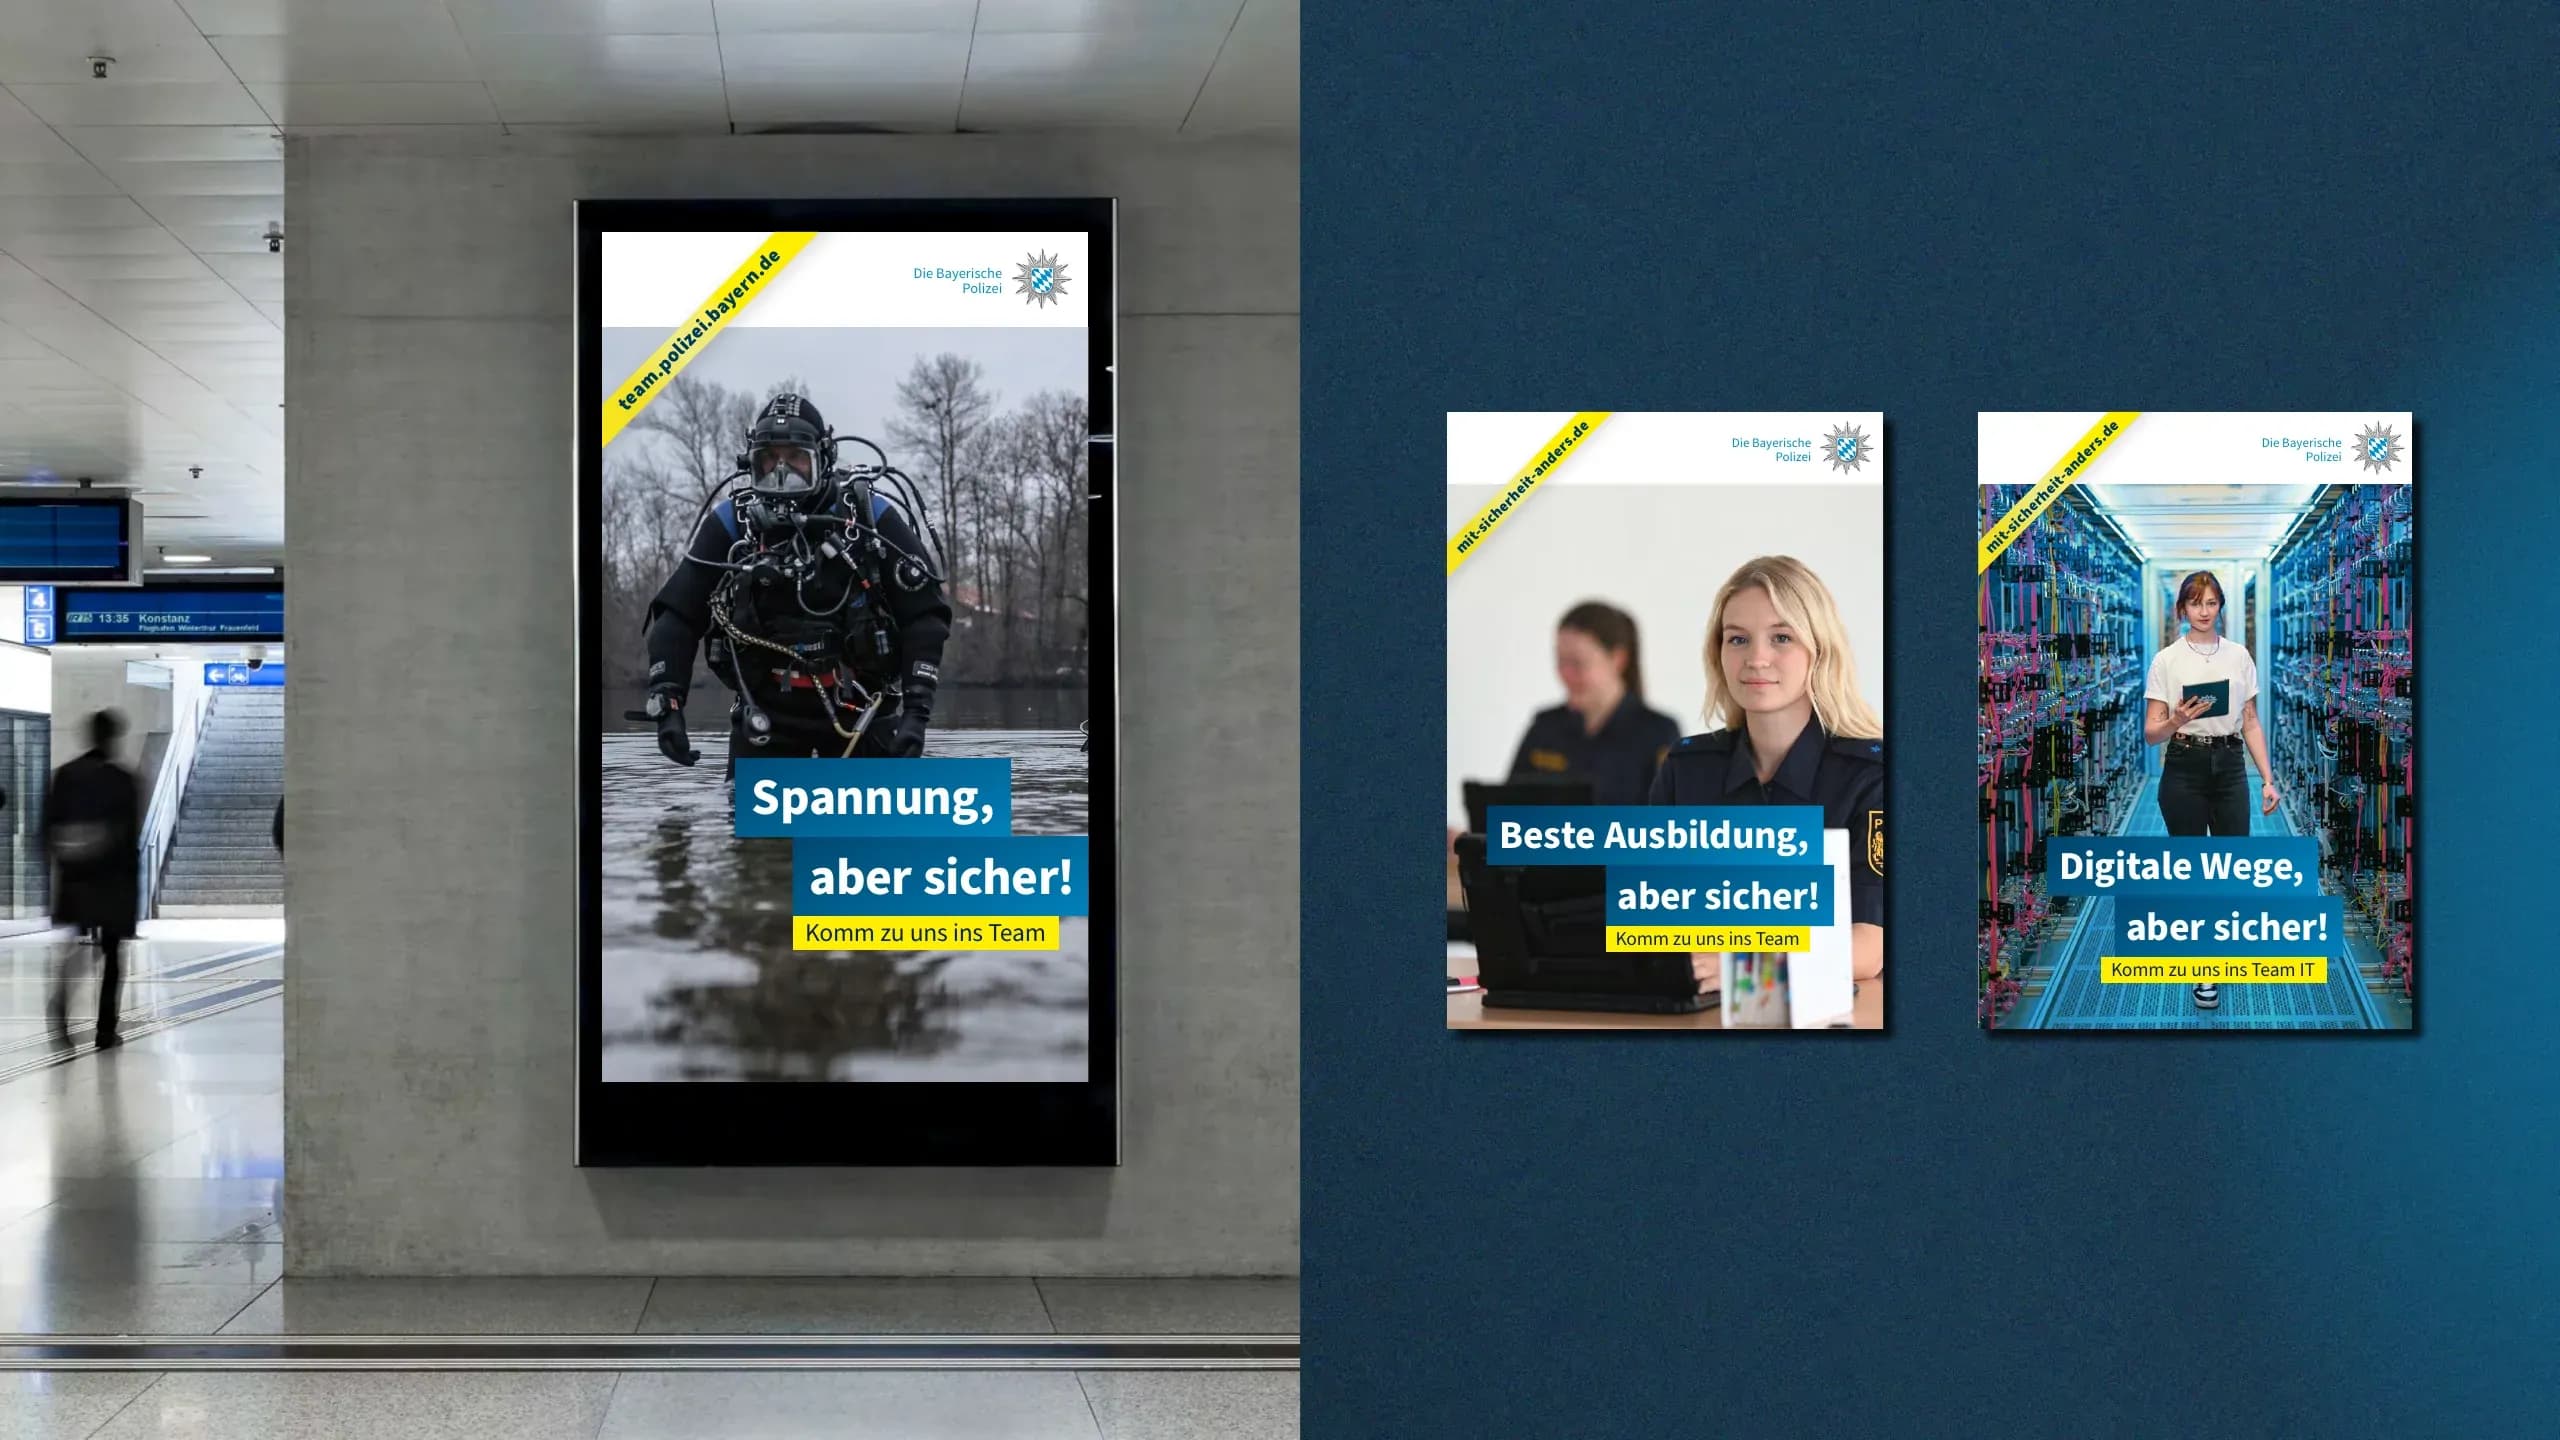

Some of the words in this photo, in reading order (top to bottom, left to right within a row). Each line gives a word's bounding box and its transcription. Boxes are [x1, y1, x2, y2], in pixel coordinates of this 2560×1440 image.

[913, 267, 934, 279] Die
[936, 267, 1002, 282] Bayerische
[962, 282, 1002, 294] Polizei
[618, 249, 781, 410] team.polizei.bayern.de
[1732, 437, 1750, 448] Die
[1752, 437, 1812, 450] Bayerische
[2262, 437, 2280, 448] Die
[2282, 437, 2342, 450] Bayerische
[1775, 451, 1811, 462] Polizei
[2306, 451, 2342, 462] Polizei
[1456, 421, 1589, 554] mit-sicherheit-anders.de
[1986, 421, 2119, 554] mit-sicherheit-anders.de
[32, 592, 48, 609] 4
[98, 613, 130, 623] 13:35
[139, 614, 191, 623] Konstanz
[33, 622, 47, 639] 5
[752, 779, 993, 826] Spannung,
[1501, 821, 1595, 849] Beste
[1603, 820, 1808, 857] Ausbildung,
[810, 857, 913, 896] aber
[924, 856, 1072, 896] sicher!
[2061, 849, 2192, 888] Digitale
[2200, 852, 2303, 888] Wege,
[1618, 880, 1697, 910] aber
[1705, 879, 1819, 910] sicher!
[806, 923, 874, 942] Komm
[880, 927, 904, 942] zu
[911, 927, 948, 942] uns
[954, 923, 983, 942] ins
[988, 923, 1045, 942] Team
[2127, 911, 2206, 941] aber
[2214, 910, 2328, 941] sicher!
[1616, 931, 1669, 946] Komm
[1673, 934, 1691, 946] zu
[1696, 934, 1725, 946] uns
[1729, 931, 1752, 946] ins
[1755, 931, 1799, 946] Team
[2112, 962, 2164, 977] Komm
[2168, 965, 2187, 977] zu
[2192, 965, 2221, 977] uns
[2225, 962, 2248, 977] ins
[2251, 962, 2295, 977] Team
[2300, 962, 2315, 977] IT
